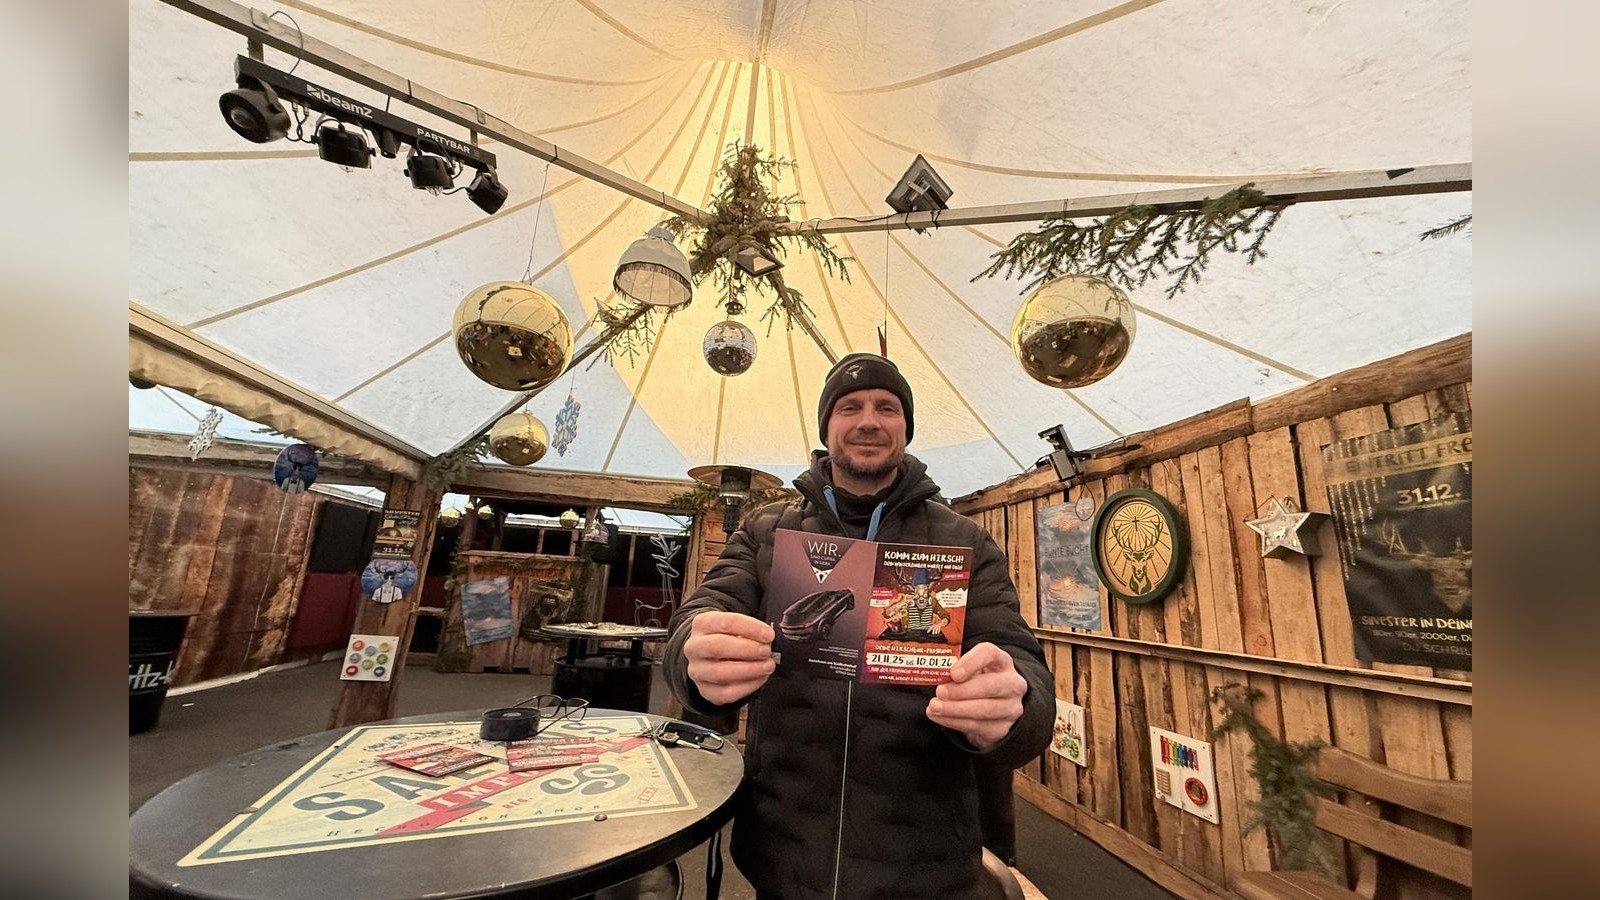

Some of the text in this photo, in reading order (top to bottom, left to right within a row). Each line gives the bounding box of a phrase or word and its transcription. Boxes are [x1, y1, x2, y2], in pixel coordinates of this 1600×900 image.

[417, 128, 471, 154] PARTYBAR
[1396, 483, 1462, 504] 31.12.
[808, 540, 841, 557] WIR.
[884, 550, 964, 564] KOMM ZUM HIRSCH!
